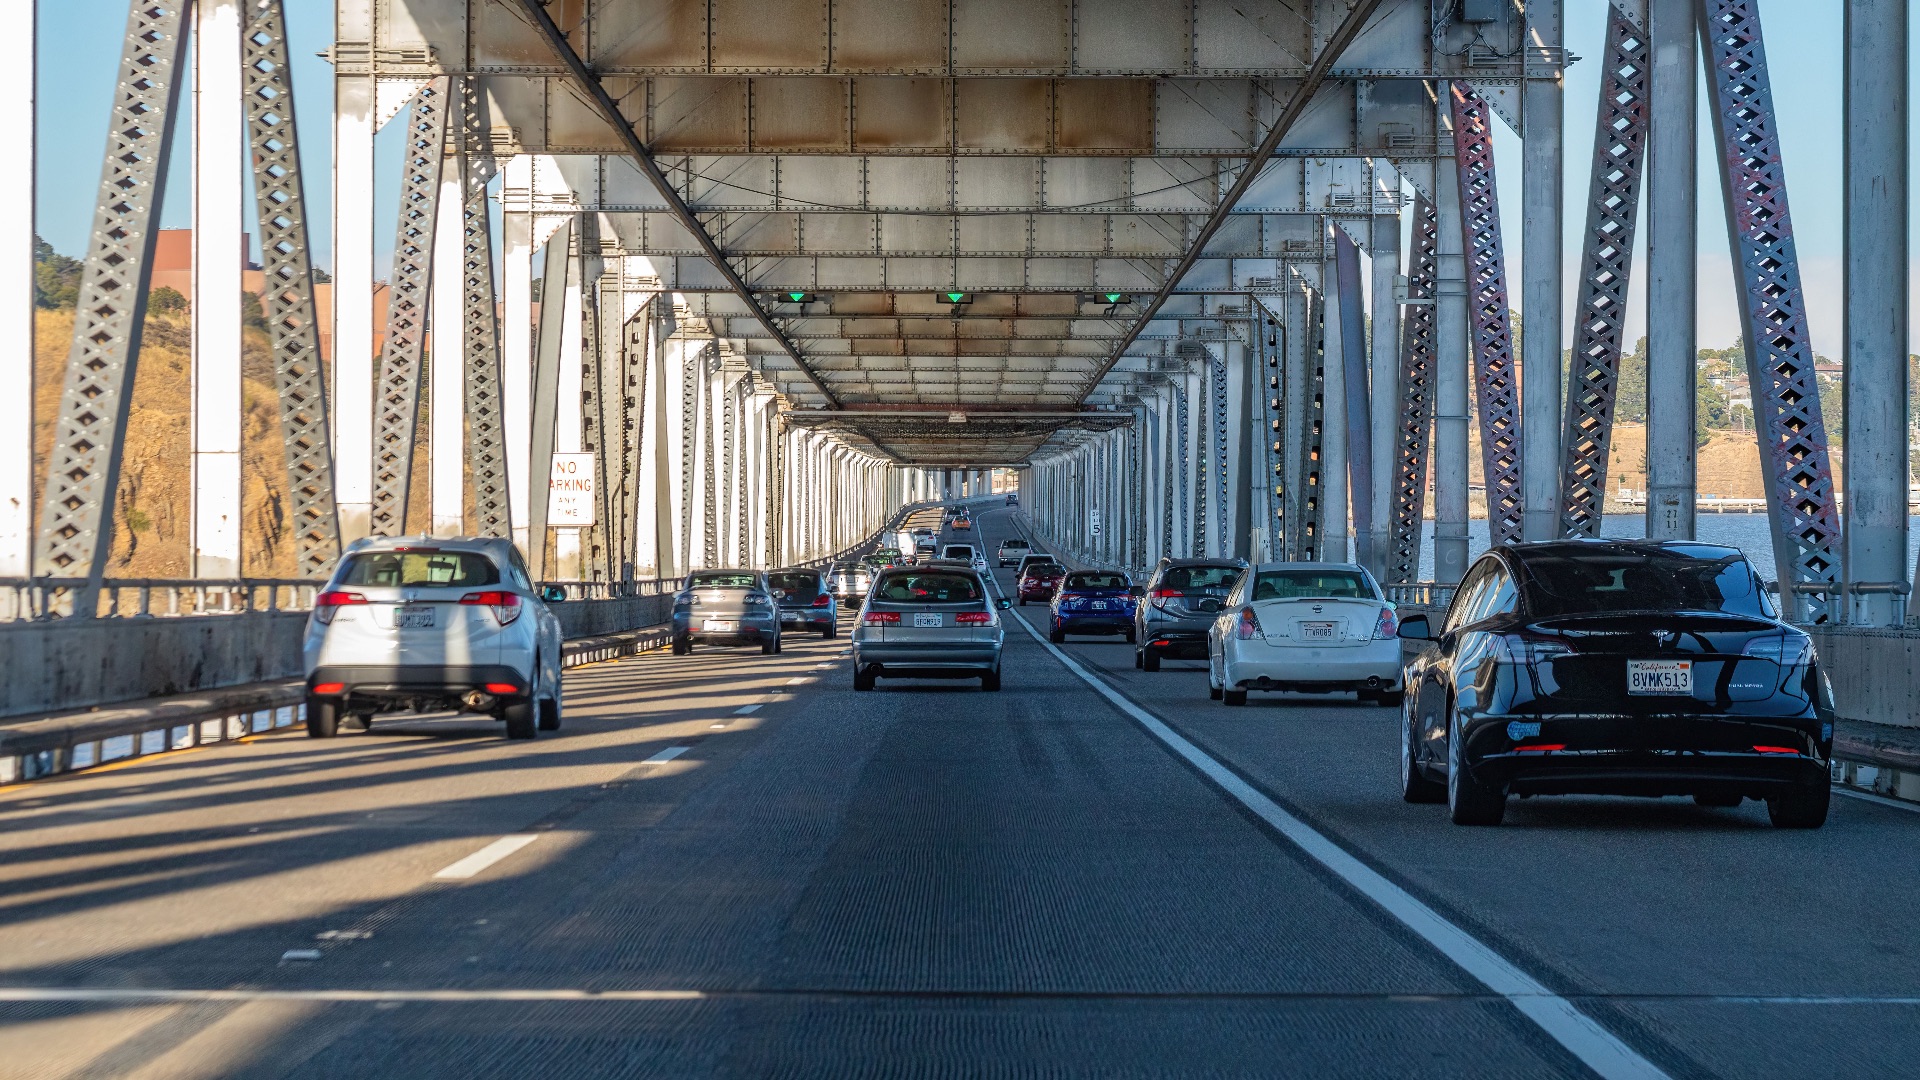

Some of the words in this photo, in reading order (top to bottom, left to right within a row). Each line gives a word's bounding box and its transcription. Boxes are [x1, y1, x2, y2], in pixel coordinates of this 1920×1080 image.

[556, 461, 577, 474] NO
[549, 478, 591, 492] ARKING
[557, 508, 578, 517] TIME
[1632, 672, 1688, 688] 8VMK513
